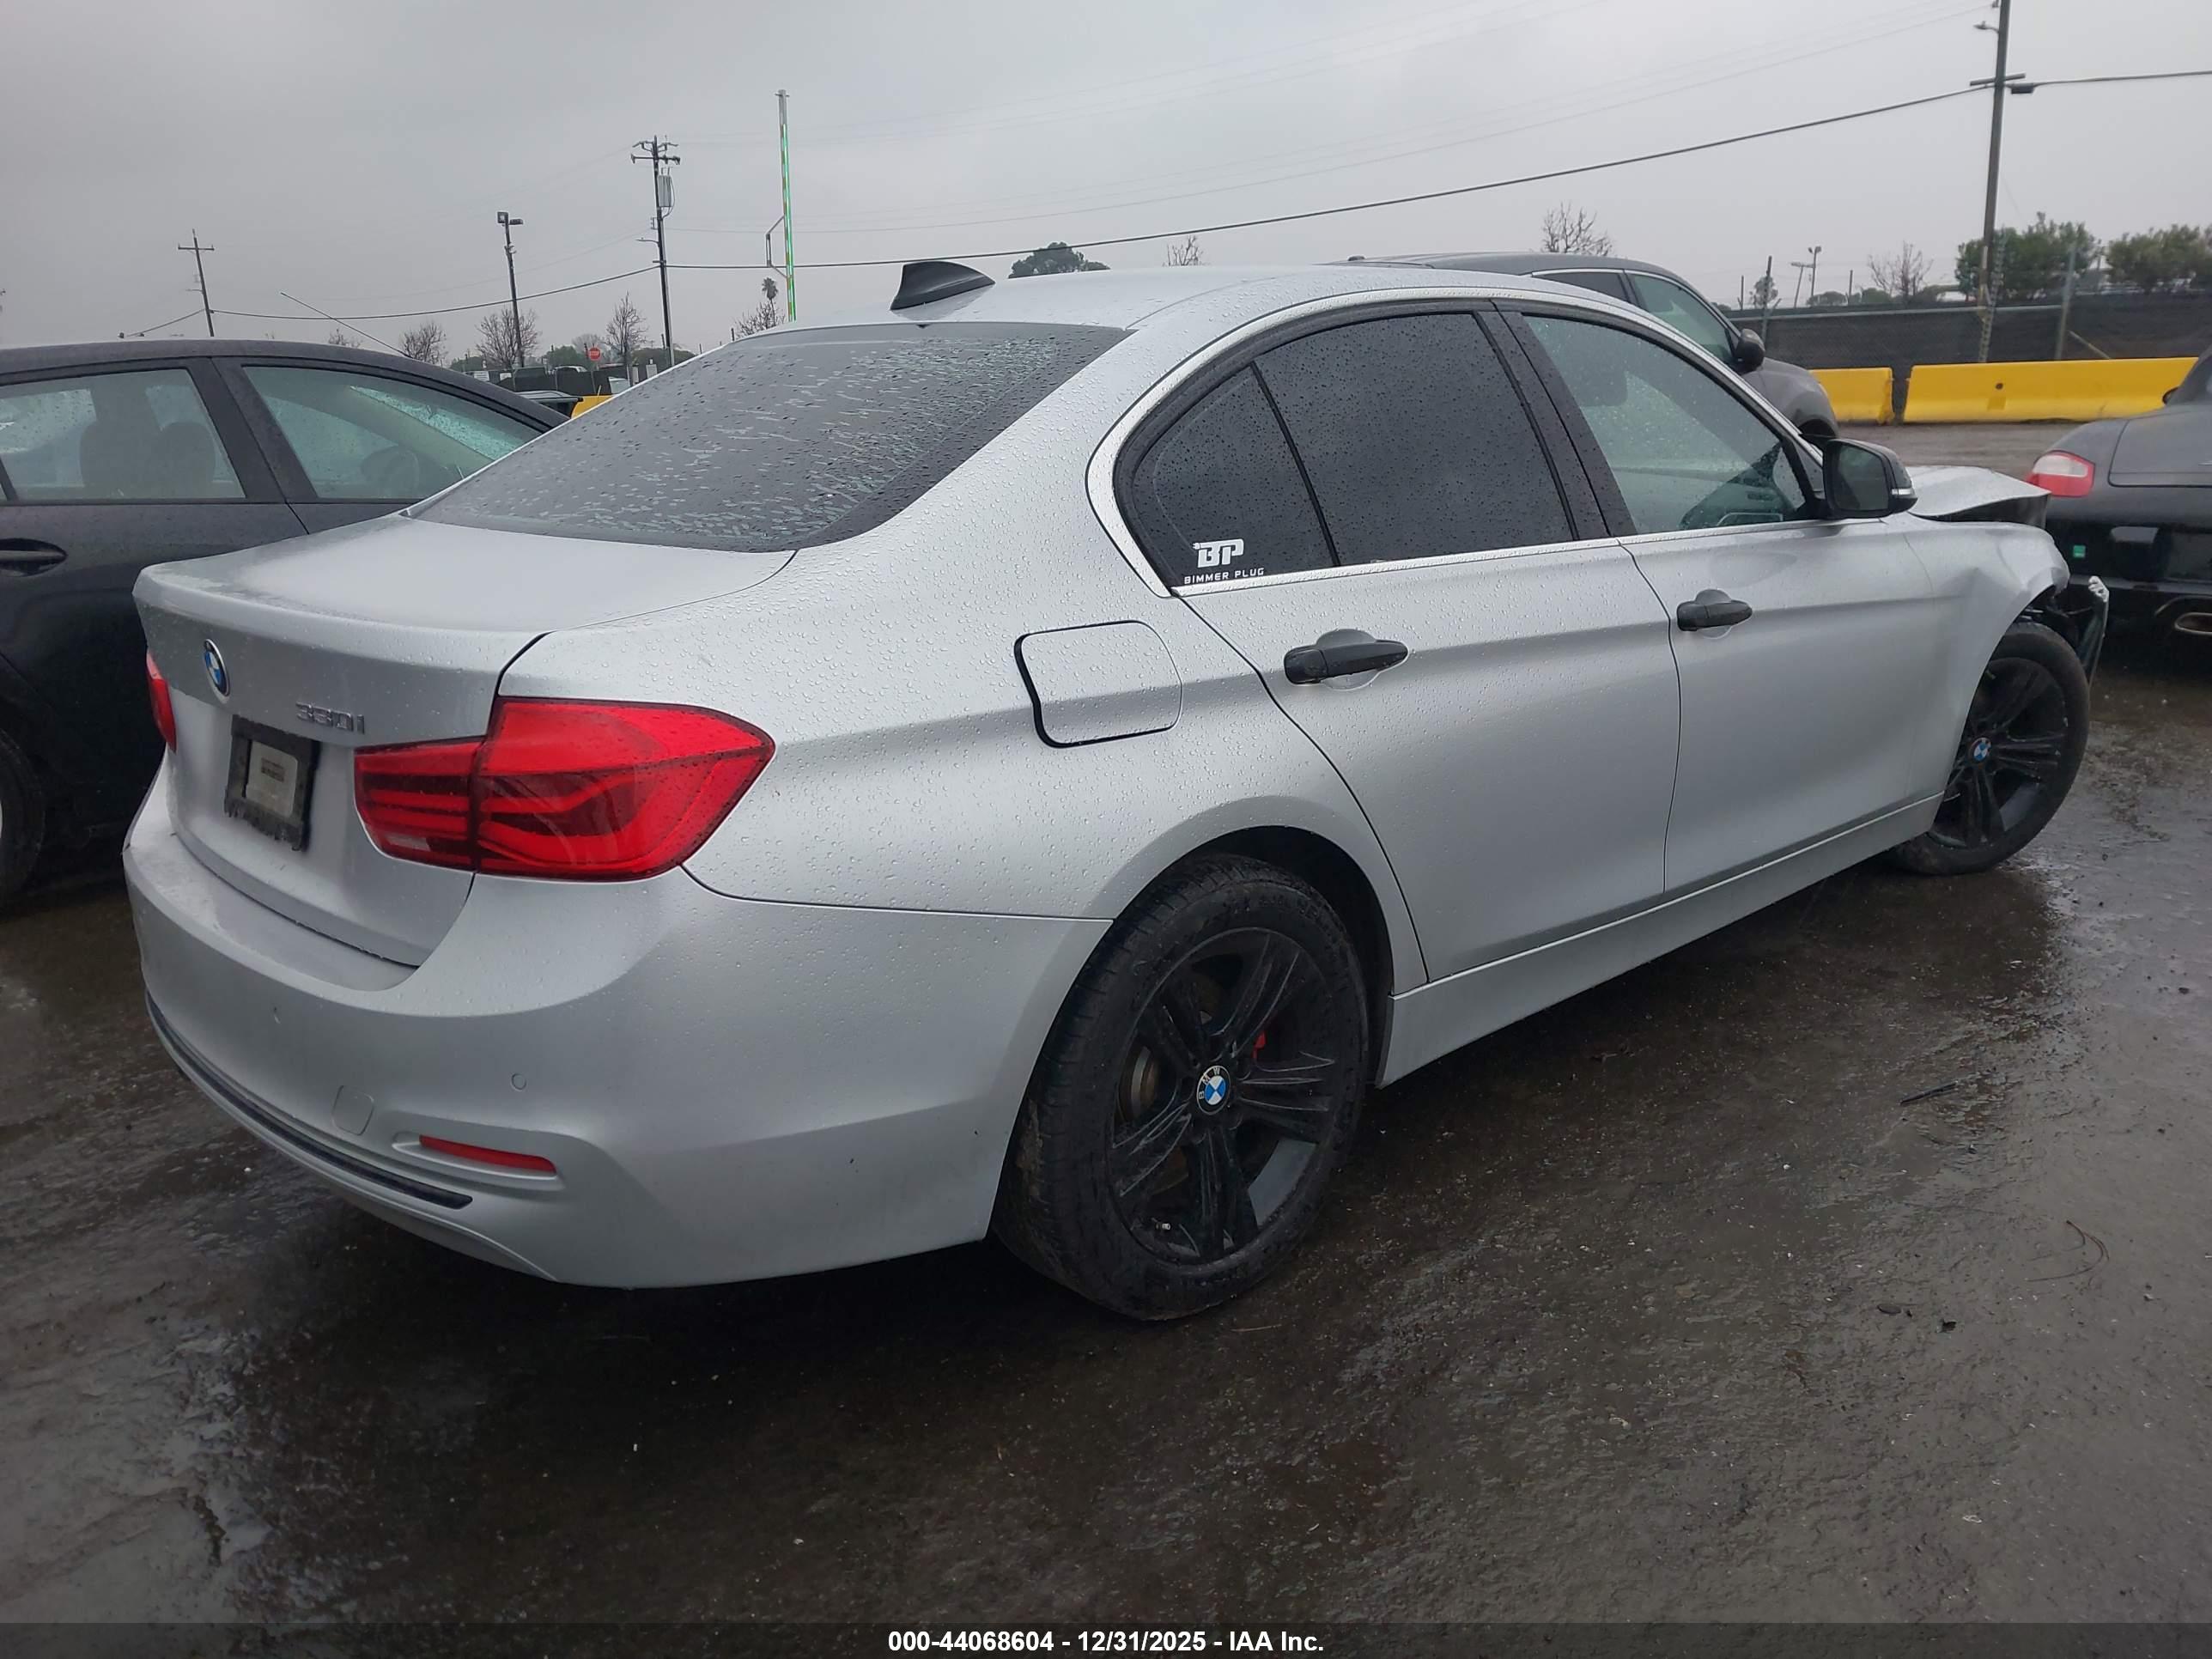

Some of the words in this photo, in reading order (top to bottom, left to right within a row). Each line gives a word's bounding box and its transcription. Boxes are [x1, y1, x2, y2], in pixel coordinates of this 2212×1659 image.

[1193, 538, 1244, 568] BP
[1184, 572, 1229, 585] BIMMER
[1234, 567, 1265, 579] PLUG
